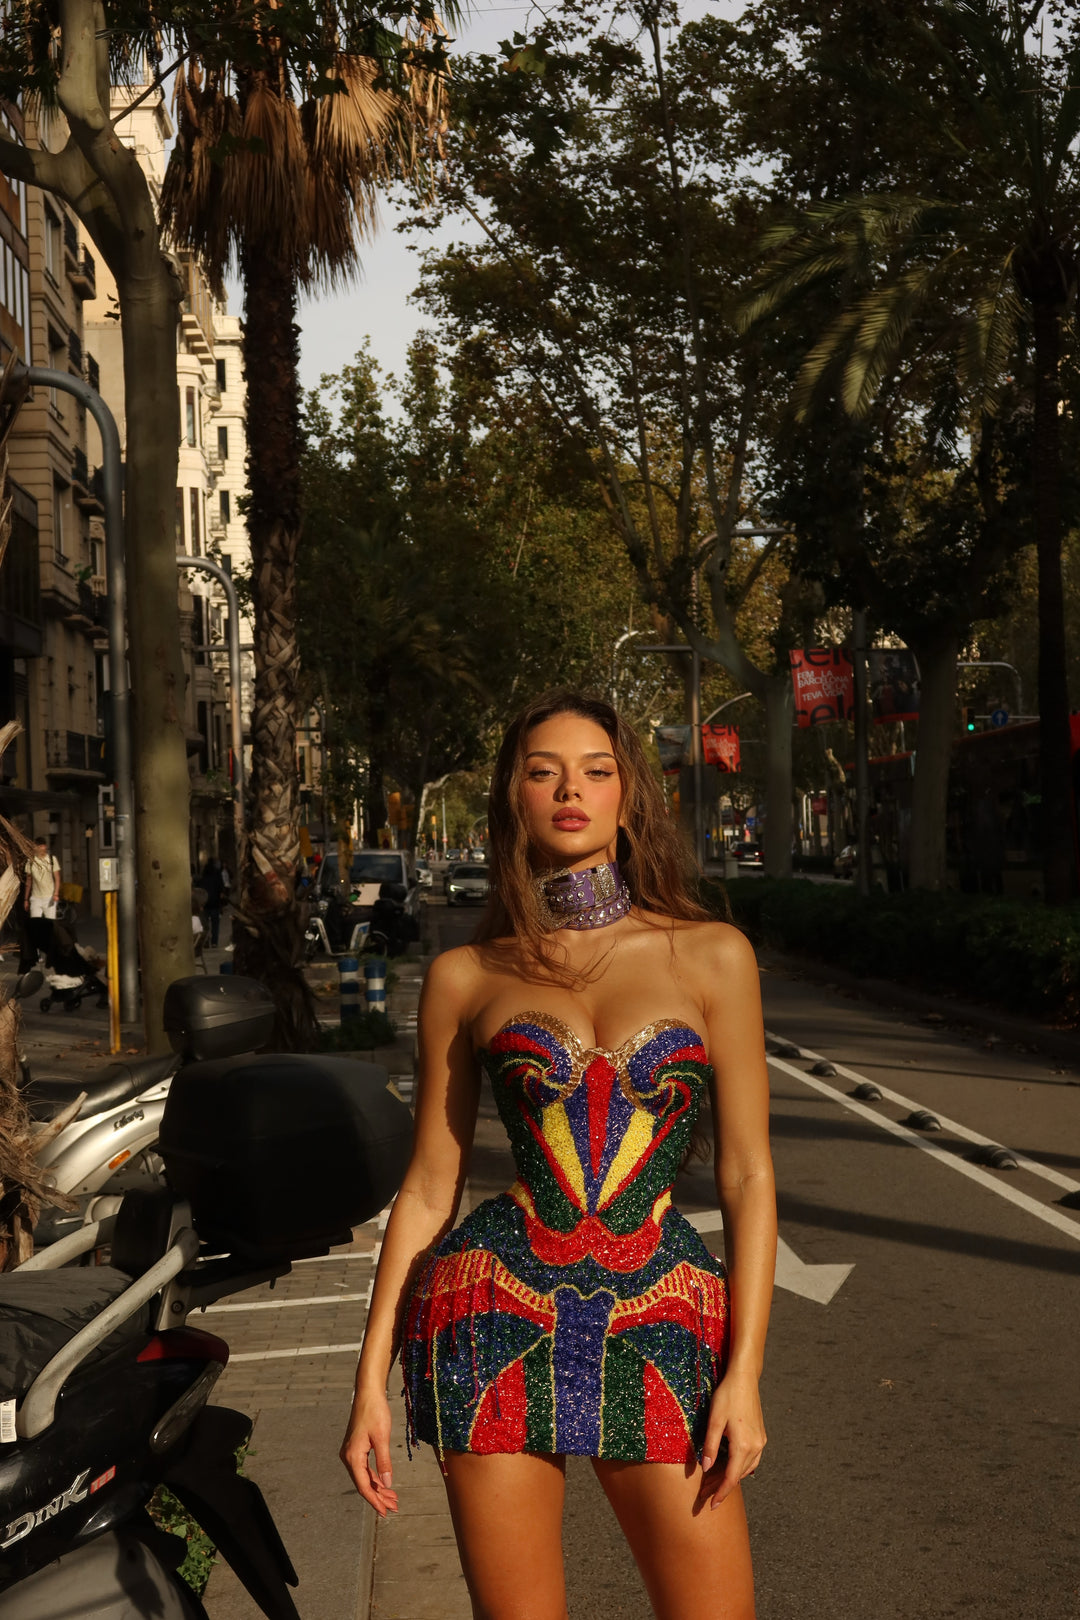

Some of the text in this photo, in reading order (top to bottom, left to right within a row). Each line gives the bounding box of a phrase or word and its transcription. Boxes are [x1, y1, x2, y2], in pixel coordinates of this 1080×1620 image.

[797, 669, 833, 680] FEM LA
[798, 675, 849, 688] BARCELONA
[836, 682, 848, 690] LA
[802, 689, 845, 702] TEVA VIDA
